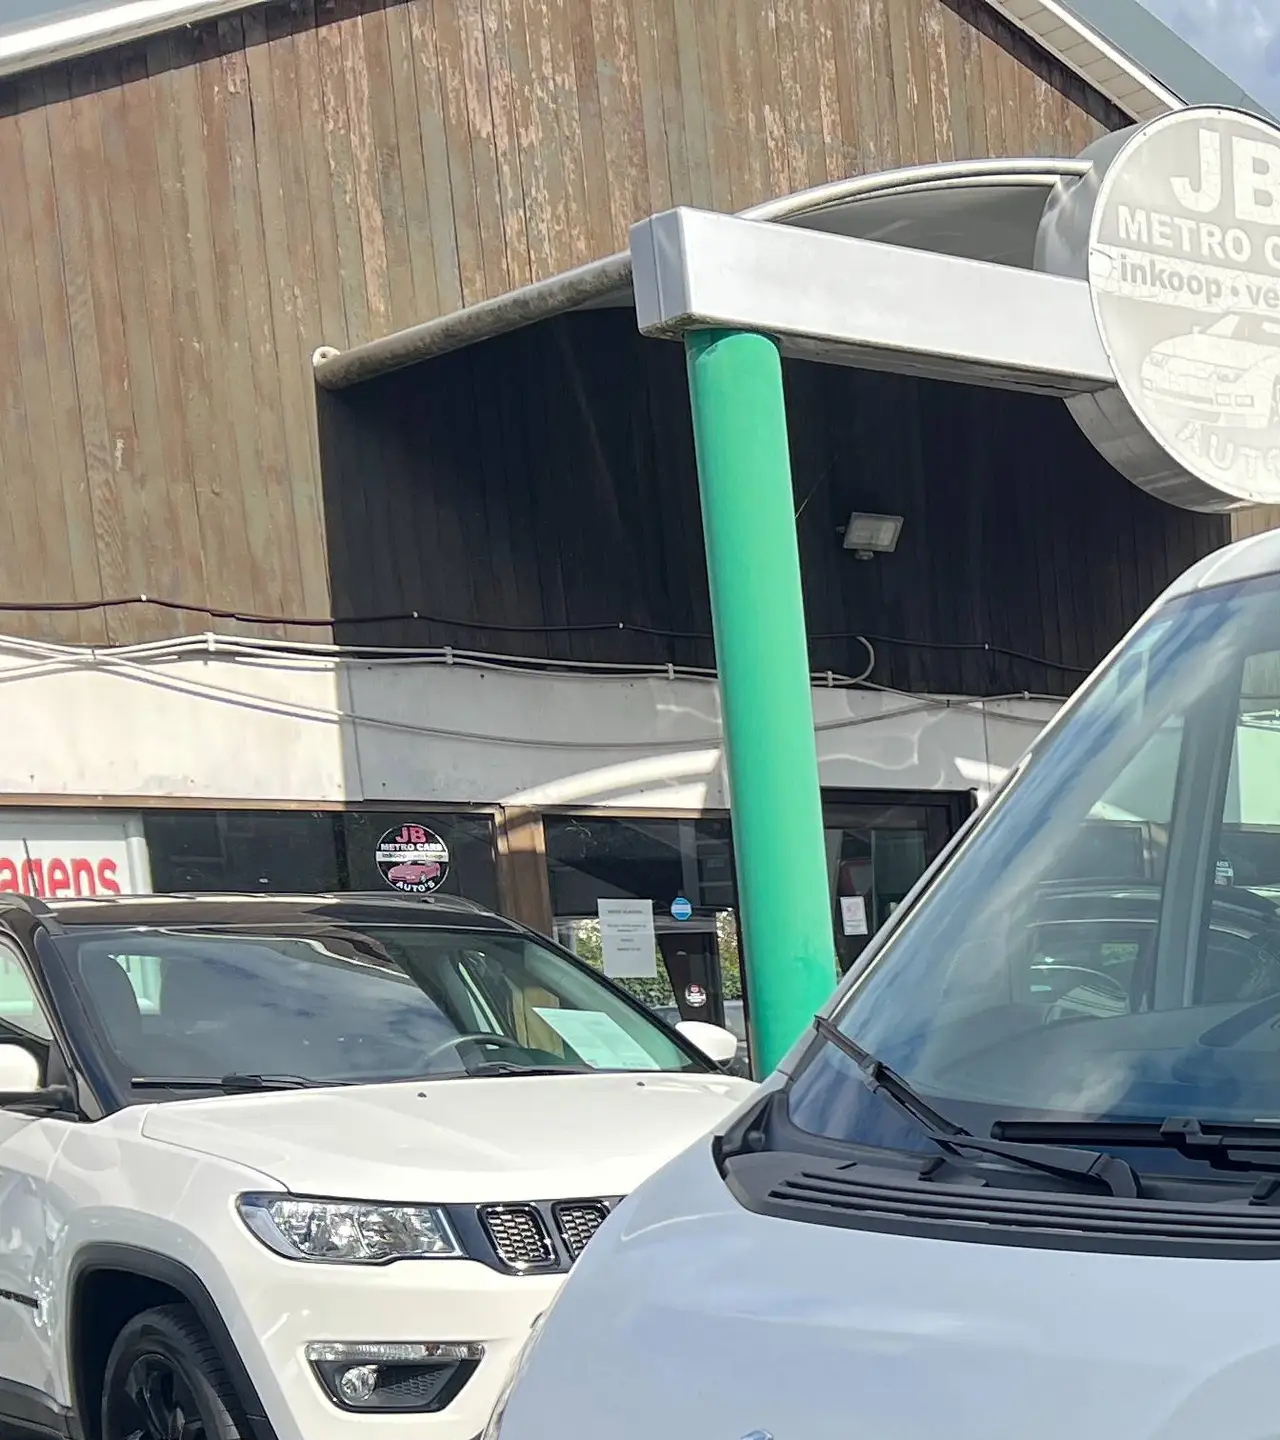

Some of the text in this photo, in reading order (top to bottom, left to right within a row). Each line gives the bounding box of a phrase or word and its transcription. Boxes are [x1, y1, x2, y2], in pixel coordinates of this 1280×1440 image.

[1117, 205, 1252, 263] METRO
[1120, 254, 1223, 303] inkoop
[395, 827, 426, 843] JB
[381, 843, 415, 851] METRO
[396, 880, 435, 892] AUTO'S
